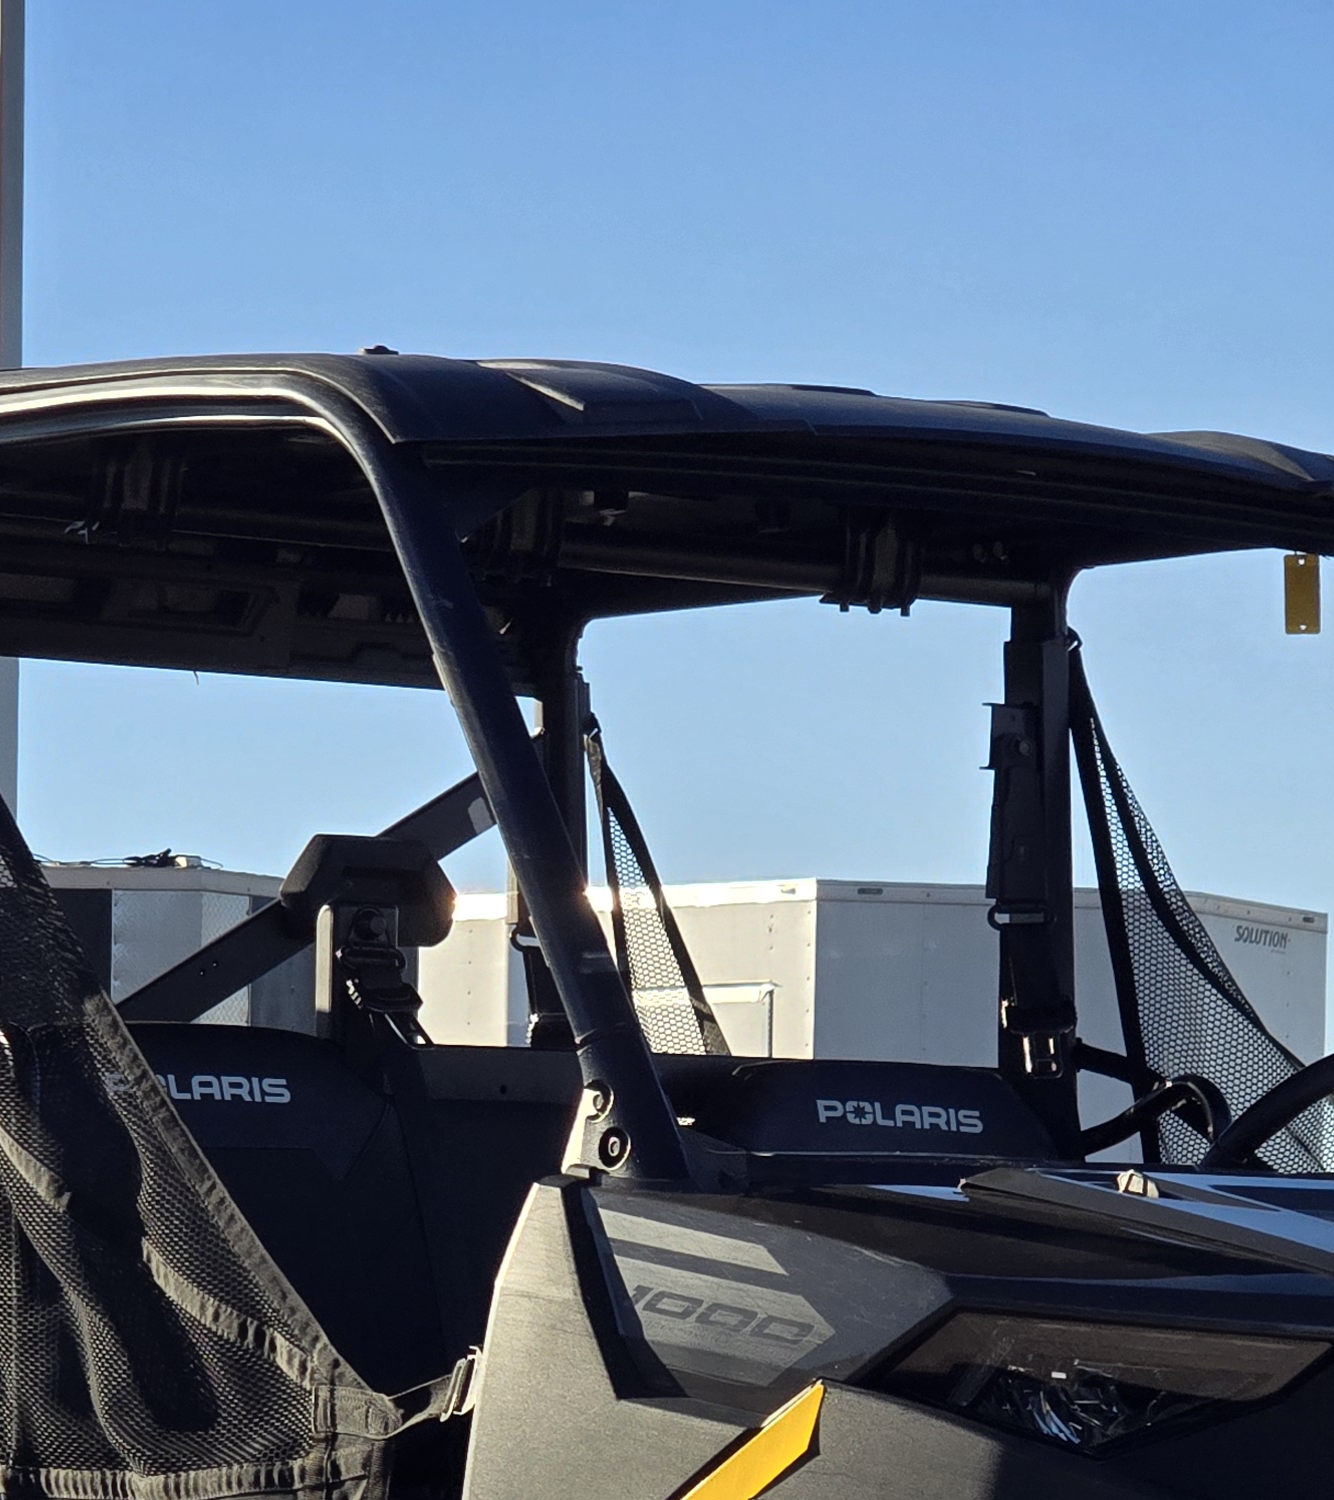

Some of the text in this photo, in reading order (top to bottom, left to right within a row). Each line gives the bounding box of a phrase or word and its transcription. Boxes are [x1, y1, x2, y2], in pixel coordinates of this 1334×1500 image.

[1234, 925, 1289, 949] SOLUTION
[816, 1099, 984, 1134] POLARIS
[630, 1284, 816, 1345] 1000
